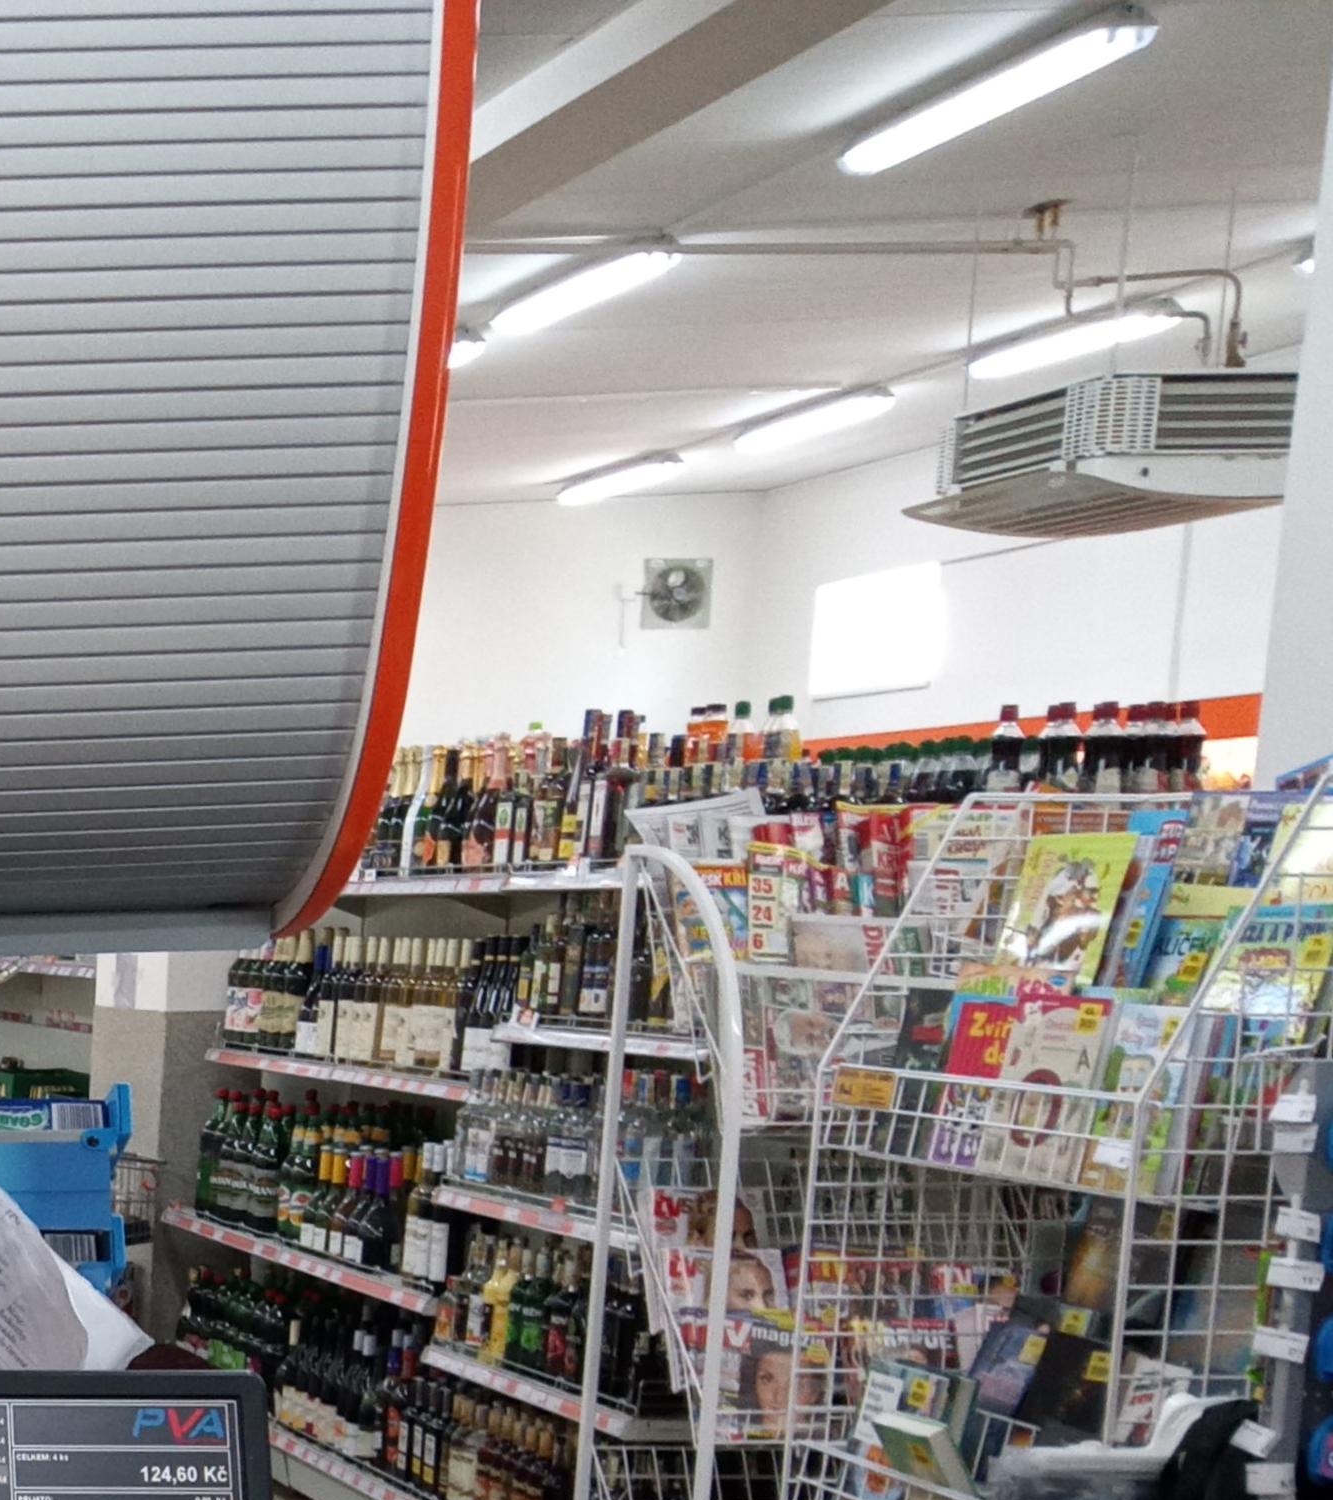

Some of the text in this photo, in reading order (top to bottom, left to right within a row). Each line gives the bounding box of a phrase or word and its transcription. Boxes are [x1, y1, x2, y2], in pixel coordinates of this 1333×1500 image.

[751, 877, 774, 895] 35
[751, 903, 774, 922] 24
[132, 1407, 226, 1440] PVA
[140, 1465, 228, 1485] 124,60 Kč
